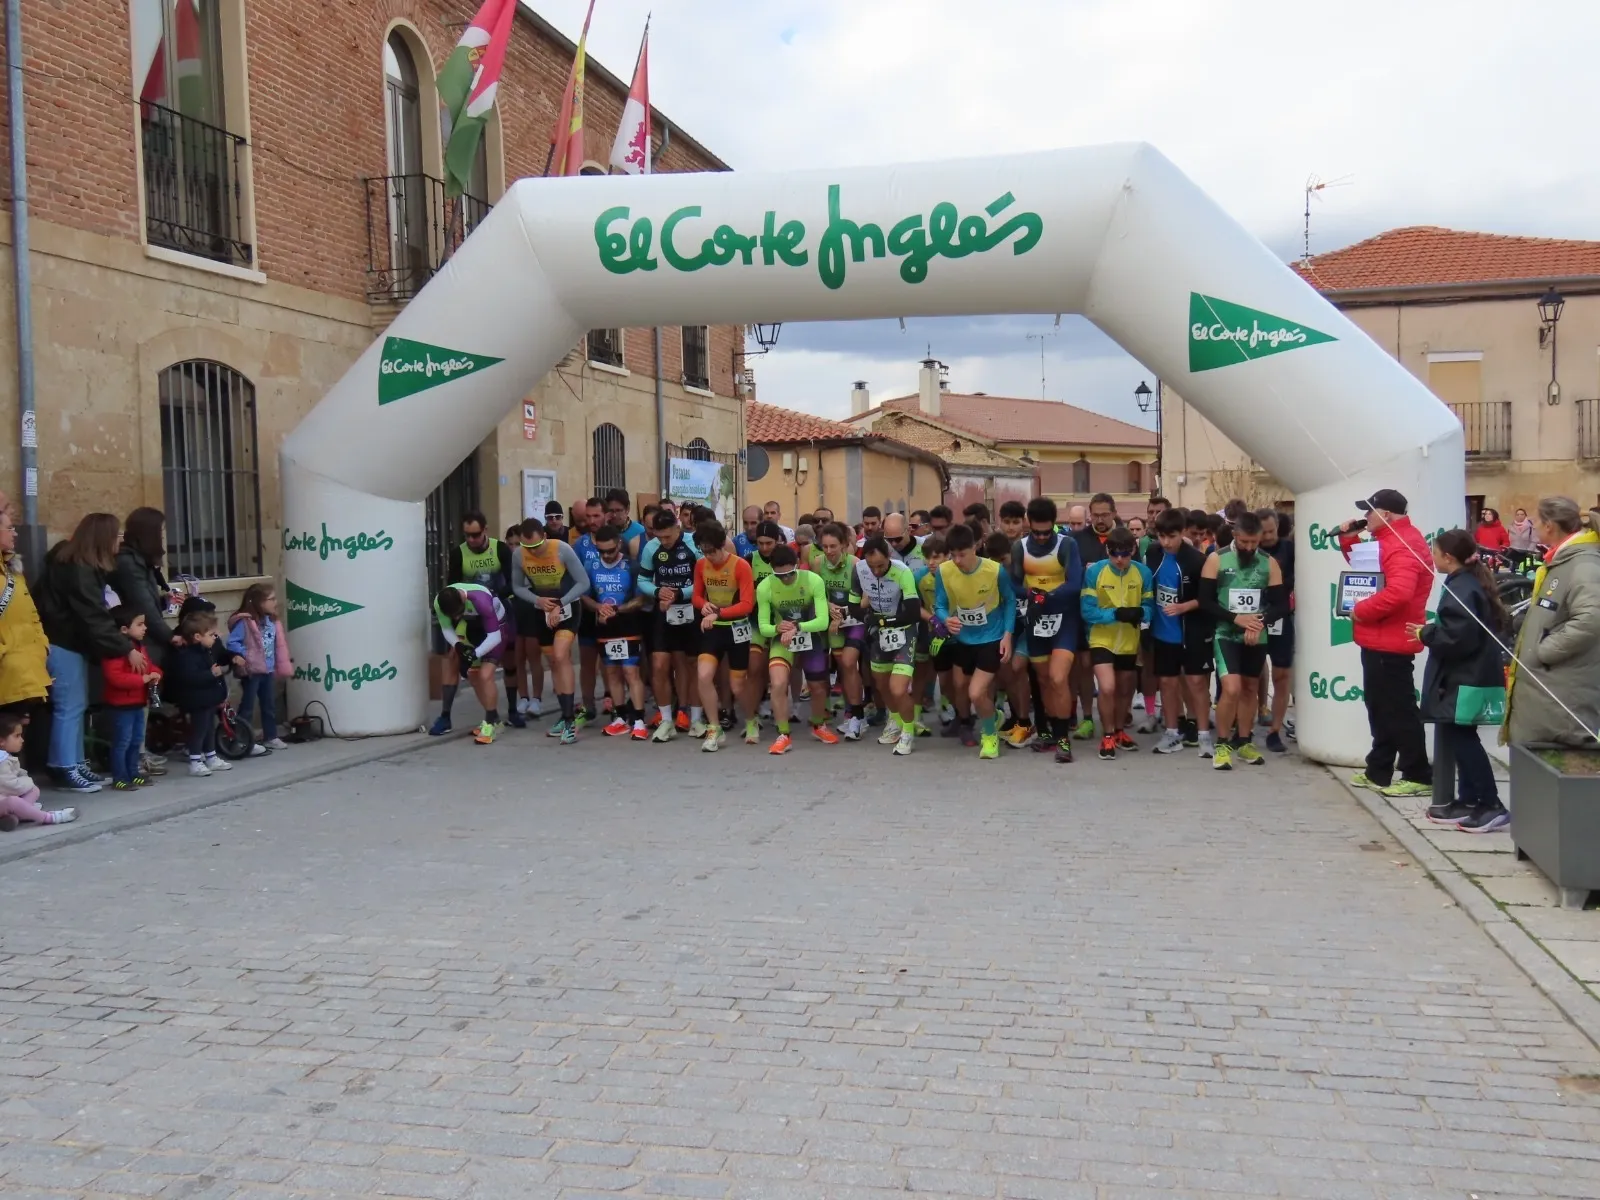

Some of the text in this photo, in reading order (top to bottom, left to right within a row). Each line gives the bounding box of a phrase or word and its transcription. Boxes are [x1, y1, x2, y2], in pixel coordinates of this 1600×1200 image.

[594, 184, 1043, 290] El Corte Inglés
[1191, 320, 1307, 348] El Corte Inglés
[381, 353, 475, 377] El Corte Inglés
[319, 522, 394, 560] Inglés
[1309, 523, 1328, 550] El
[469, 557, 495, 569] VICENTE
[527, 564, 557, 575] TORRES
[605, 583, 623, 592] MSC
[1237, 595, 1254, 606] 30
[676, 609, 685, 619] 3
[960, 612, 984, 622] 103
[1041, 620, 1056, 630] 57
[884, 633, 899, 644] 18
[610, 644, 623, 654] 45
[324, 653, 398, 691] Inglés
[1309, 671, 1328, 699] El
